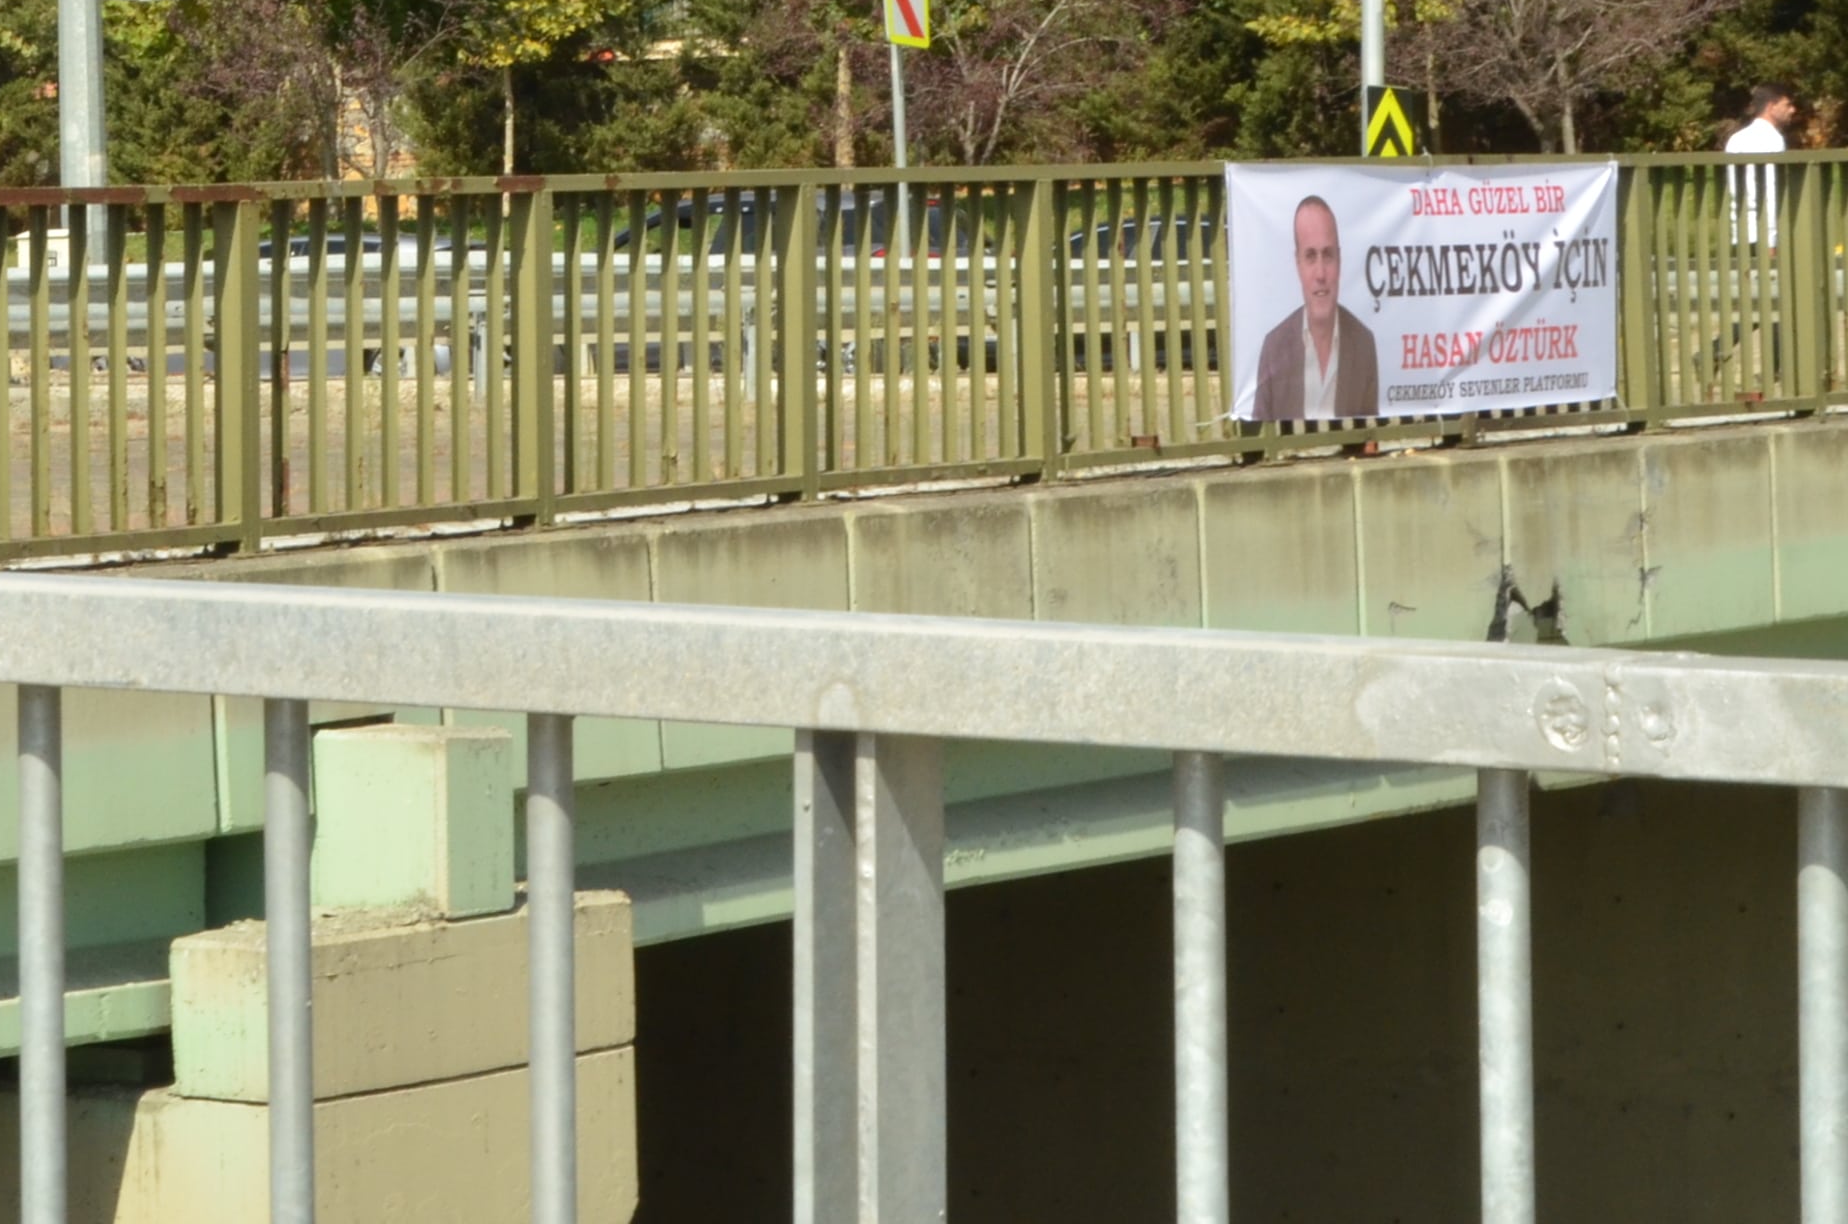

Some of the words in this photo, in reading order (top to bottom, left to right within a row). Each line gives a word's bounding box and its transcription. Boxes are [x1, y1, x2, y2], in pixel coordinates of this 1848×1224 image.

[1410, 187, 1463, 215] DAHA
[1468, 181, 1530, 214] GÜZEL
[1532, 179, 1566, 212] BİR
[1365, 229, 1541, 312] ÇEKMEKÖY
[1552, 226, 1608, 304] İÇİN
[1401, 332, 1483, 369] HASAN
[1489, 319, 1578, 364] ÖZTÜRK
[1459, 378, 1520, 397] SEVENLER
[1523, 373, 1588, 393] PLATFORMU
